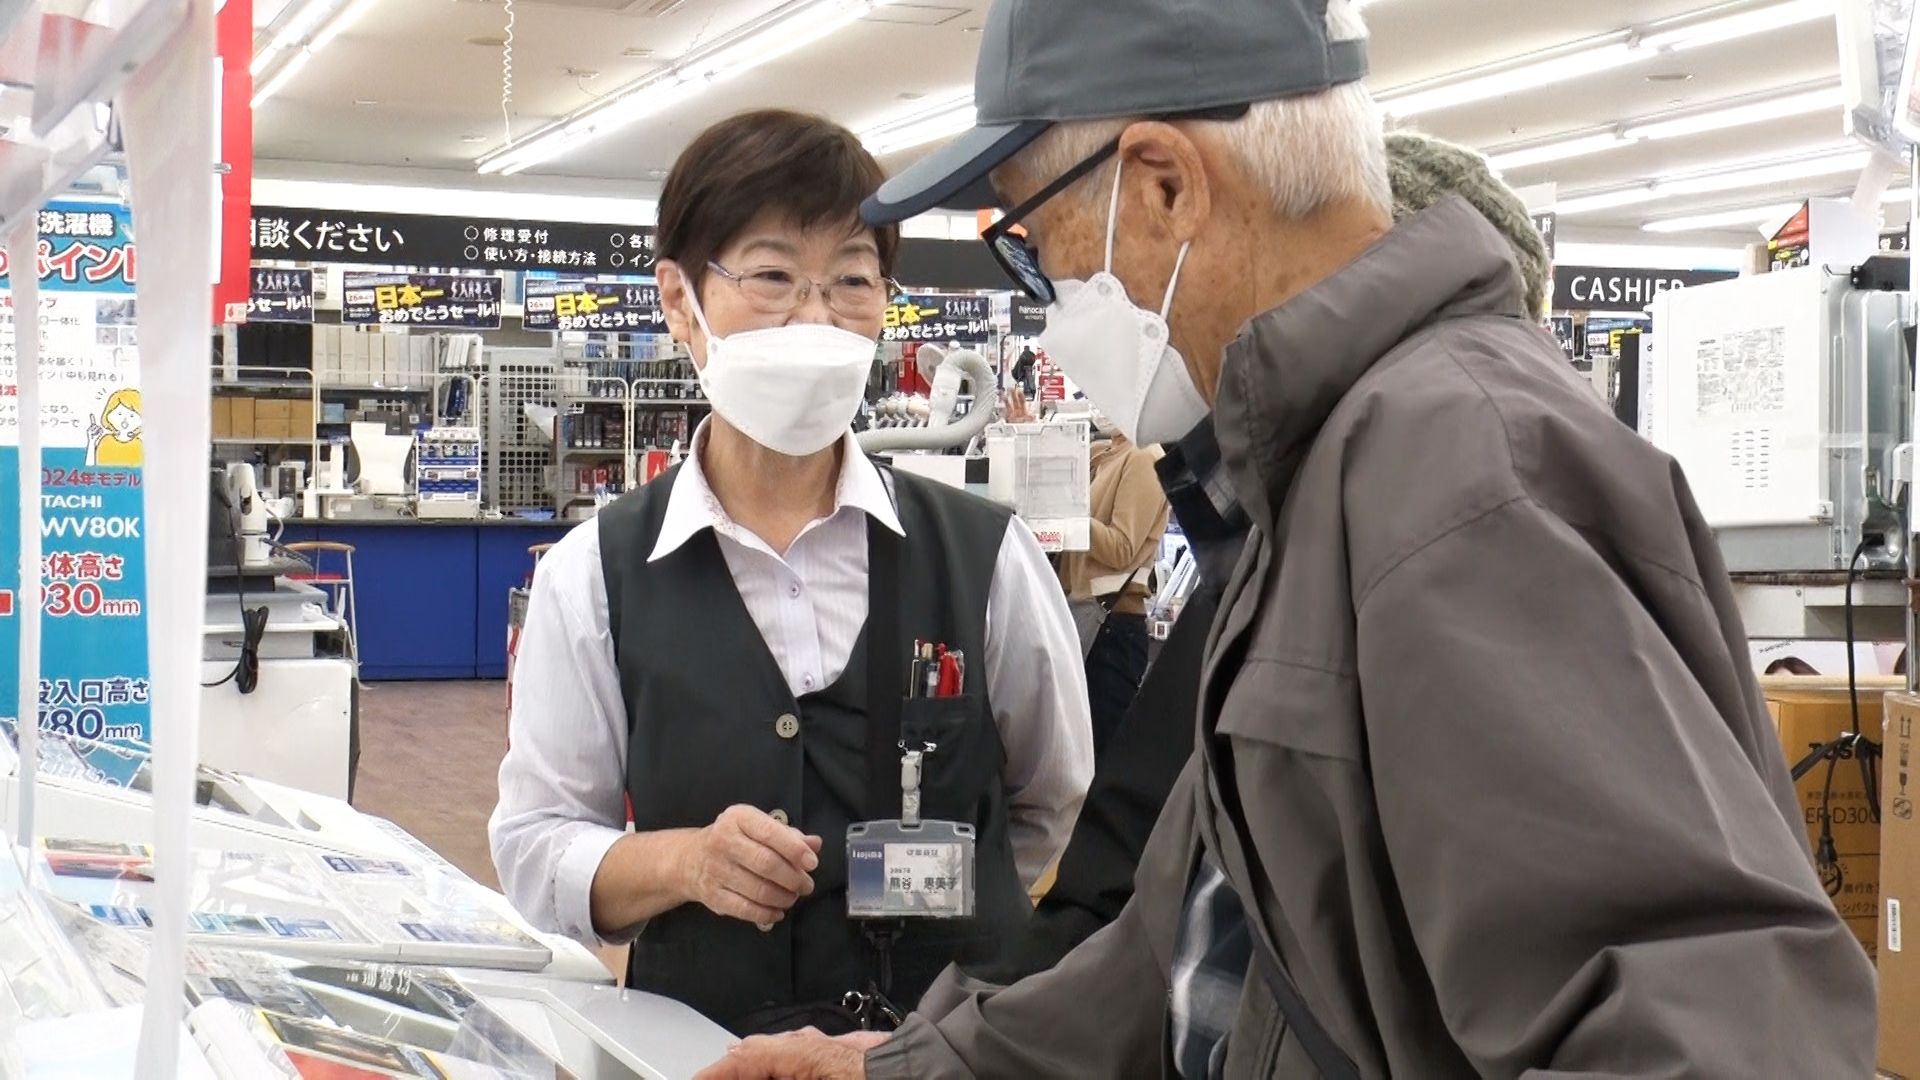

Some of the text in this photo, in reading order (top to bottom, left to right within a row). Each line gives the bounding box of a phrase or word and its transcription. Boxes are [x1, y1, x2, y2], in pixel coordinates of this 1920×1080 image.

[39, 211, 114, 236] 洗濯機
[250, 217, 404, 252] 談ください
[481, 227, 549, 244] 修理受付
[483, 247, 597, 266] 使い方・接続方法
[375, 285, 444, 310] 日本一
[555, 292, 620, 316] 日本一
[883, 303, 940, 328] 日本一
[883, 319, 989, 341] おめでとうセール!!
